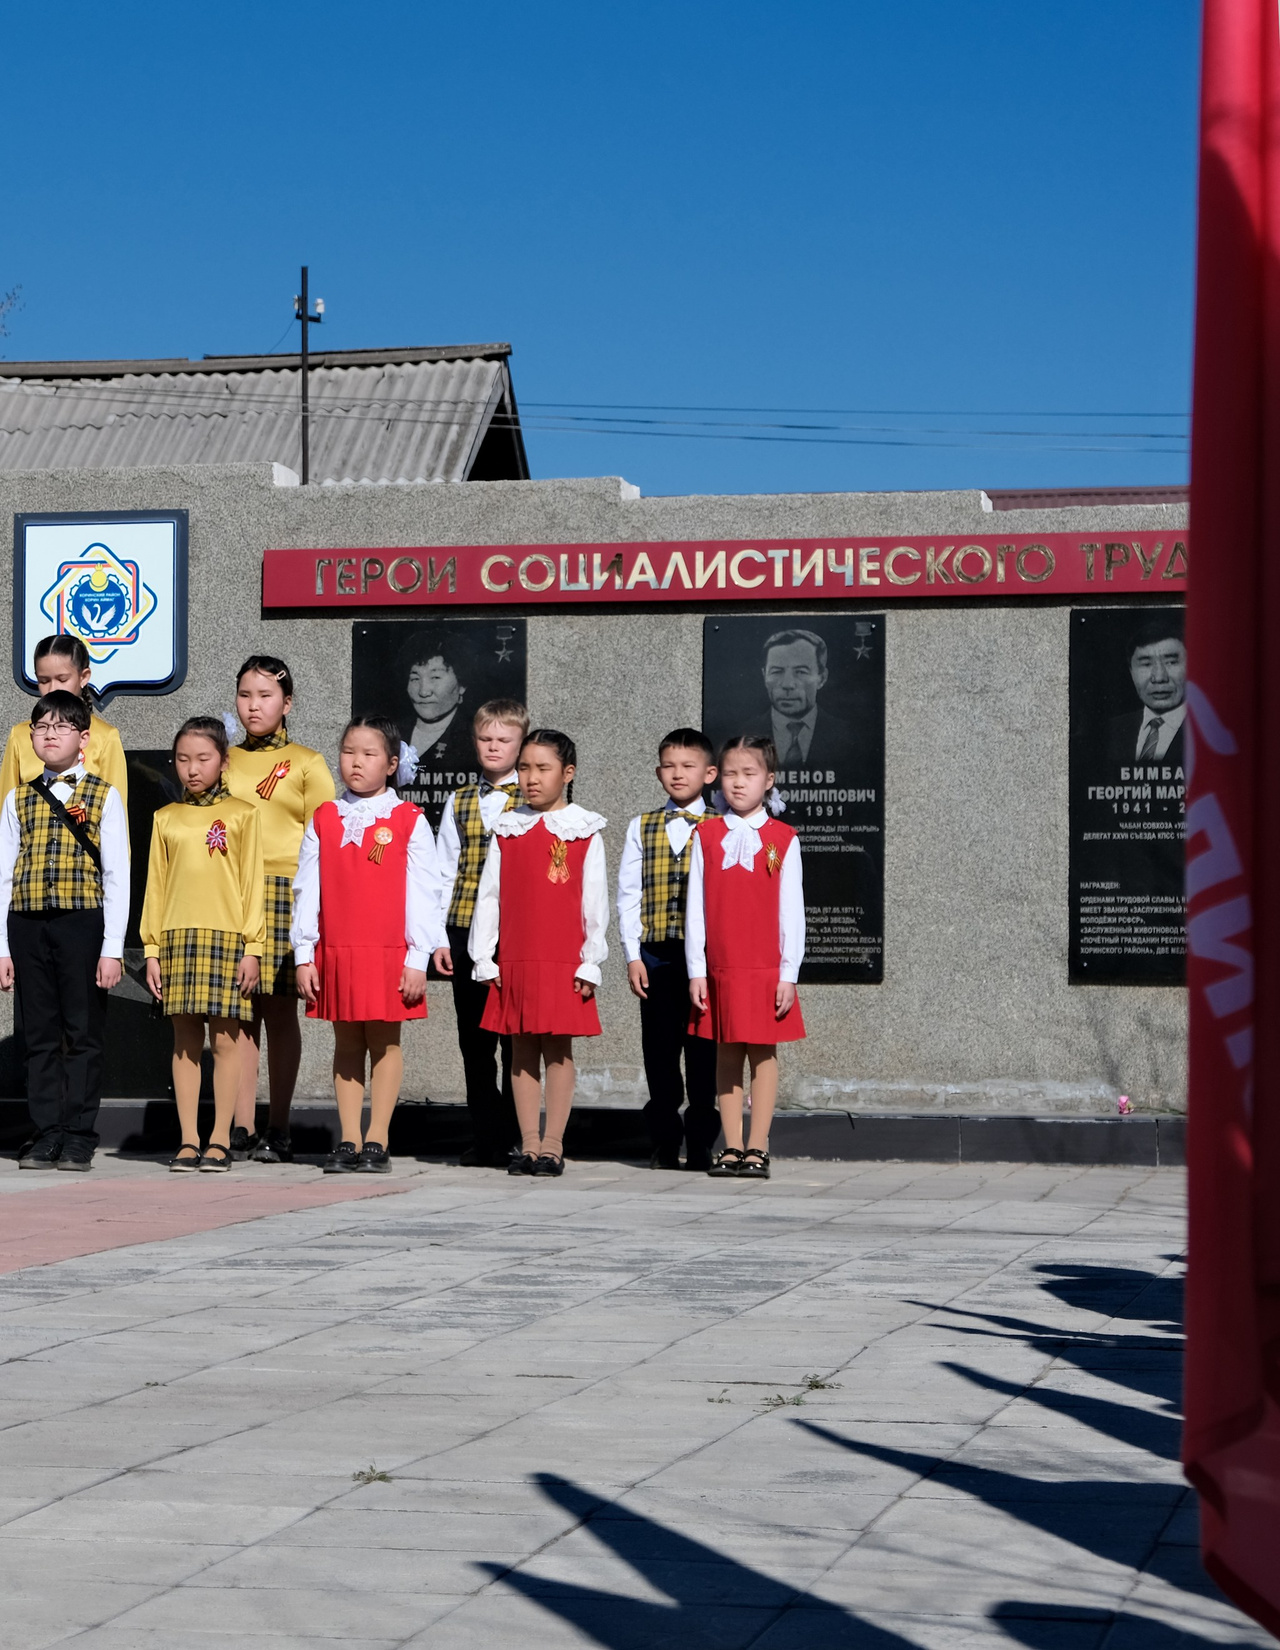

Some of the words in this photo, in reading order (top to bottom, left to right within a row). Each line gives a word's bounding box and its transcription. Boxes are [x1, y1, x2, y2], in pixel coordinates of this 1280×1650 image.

[315, 556, 457, 595] ГЕРОИ
[480, 544, 1056, 593] СОЦИАЛИСТИЧЕСКОГО
[411, 772, 478, 785] МИТОВ
[1121, 767, 1185, 780] БИМБА
[1088, 783, 1152, 799] ГЕОРГИЙ
[1156, 786, 1188, 799] МАР
[806, 806, 844, 817] 1991
[1112, 802, 1151, 814] 1941
